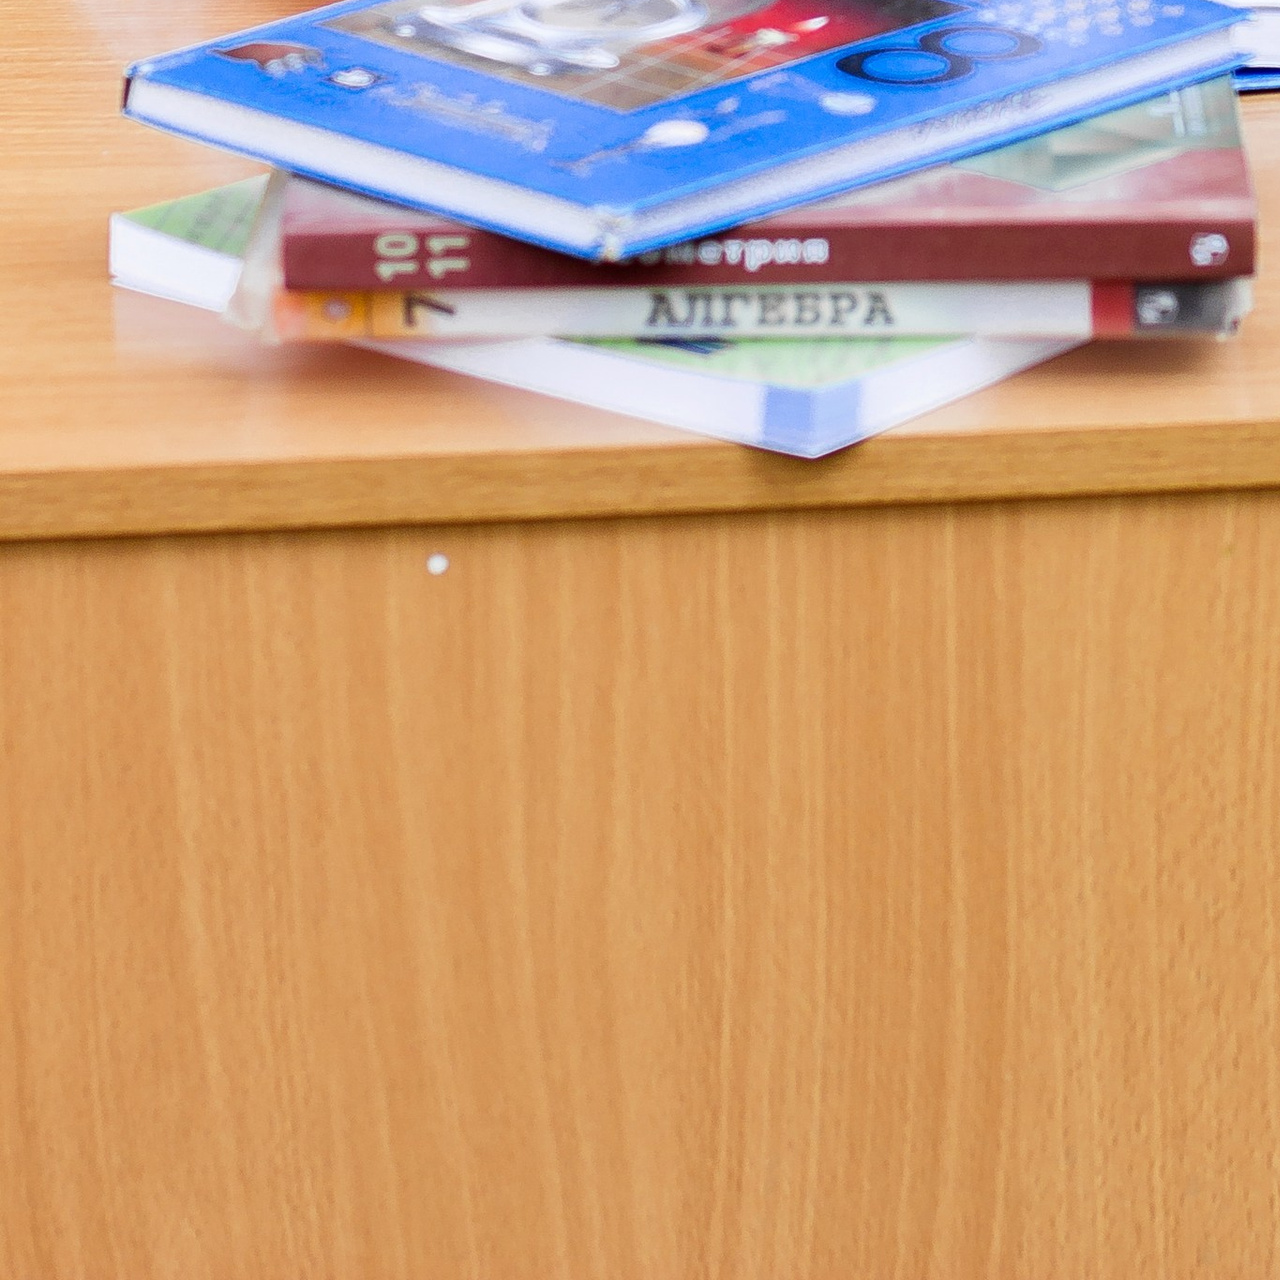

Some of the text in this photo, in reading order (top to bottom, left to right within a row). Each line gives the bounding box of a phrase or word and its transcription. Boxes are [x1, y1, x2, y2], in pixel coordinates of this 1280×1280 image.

[835, 25, 1043, 86] 8
[374, 233, 419, 282] 10
[426, 235, 470, 280] 11
[402, 291, 457, 328] 7
[646, 290, 894, 327] АЛГЕБРА
